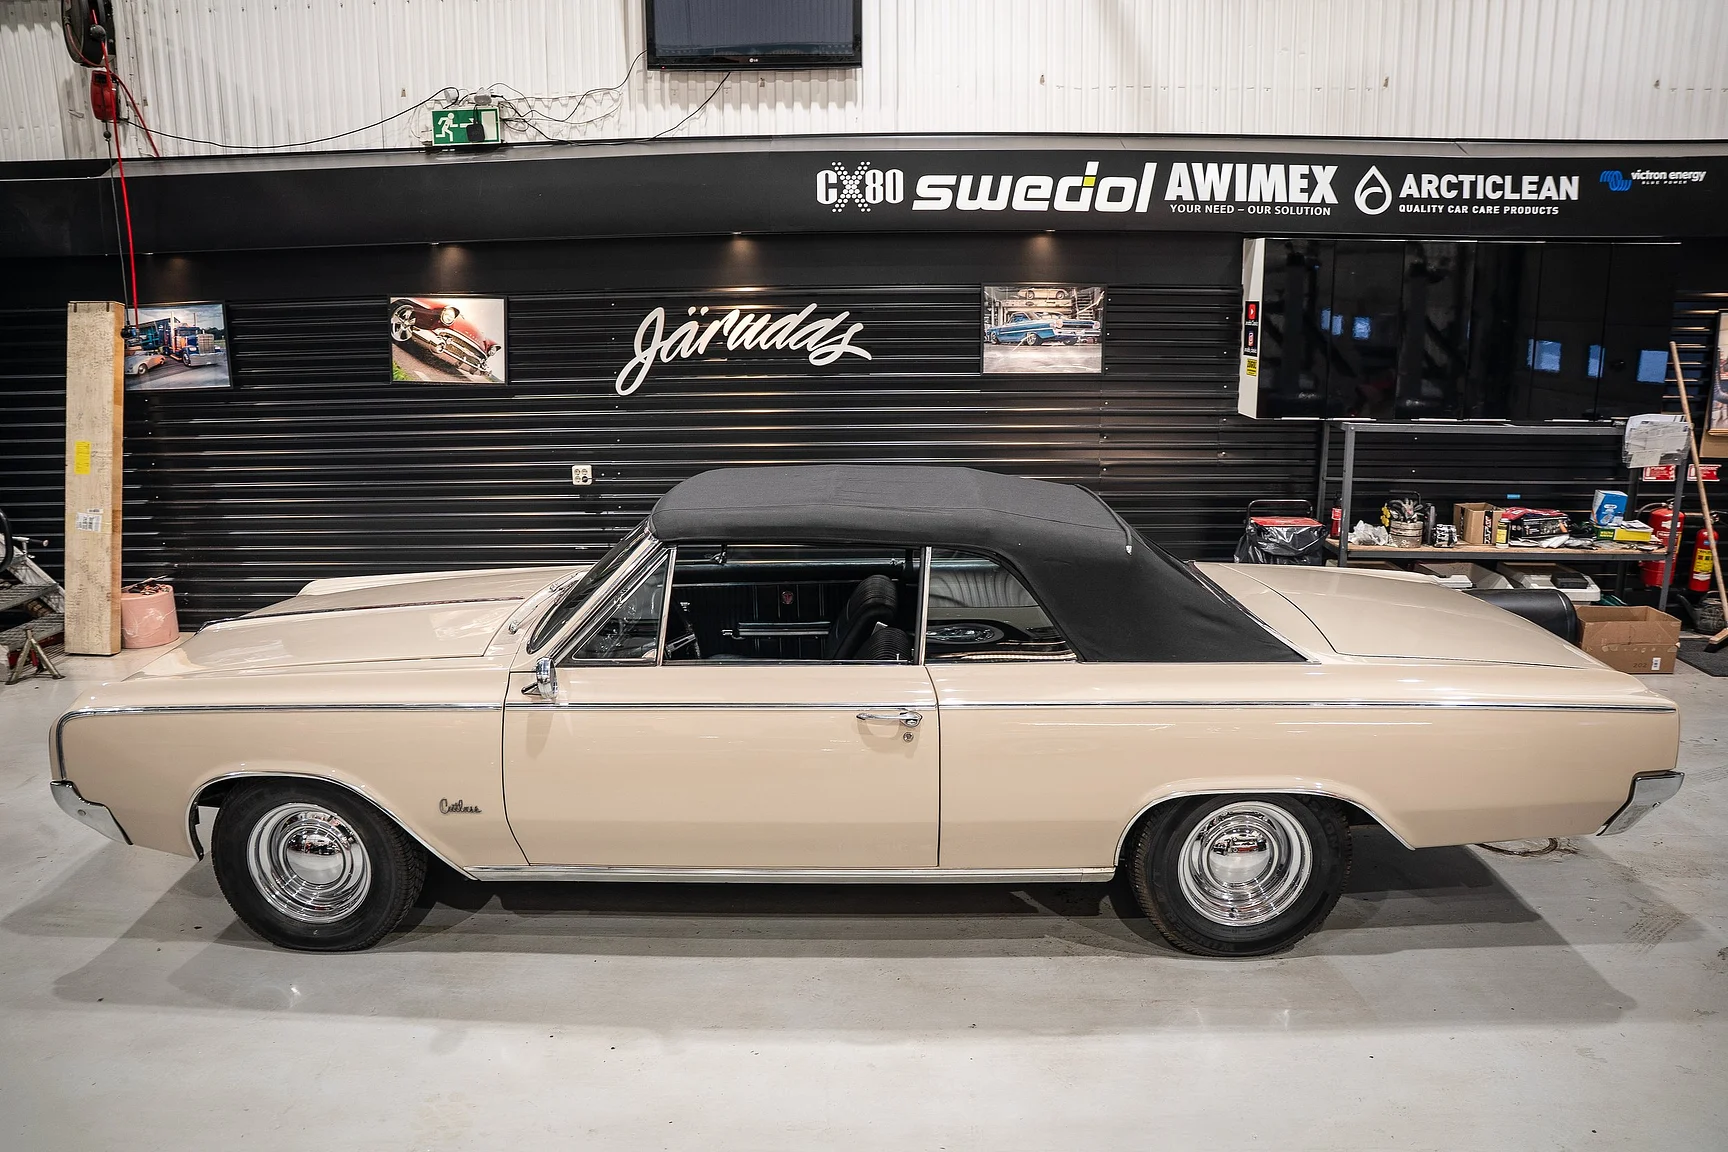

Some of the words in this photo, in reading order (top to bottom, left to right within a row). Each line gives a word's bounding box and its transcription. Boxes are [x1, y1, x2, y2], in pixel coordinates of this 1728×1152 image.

[816, 162, 904, 212] CX80
[912, 161, 1158, 213] swedol
[1164, 163, 1339, 204] AWIMEX
[1398, 173, 1580, 202] ARCTICLEAN
[1630, 169, 1667, 181] victron
[1668, 170, 1707, 183] energy
[1169, 203, 1202, 214] YOUR
[1204, 204, 1235, 214] NEED
[1247, 205, 1272, 215] OUR
[1274, 205, 1331, 216] SOLUTION
[1398, 204, 1445, 214] QUALITY
[1447, 204, 1469, 214] CAR
[1471, 205, 1501, 215] CARE
[1503, 205, 1559, 215] PRODUCTS
[615, 303, 873, 397] Järudds
